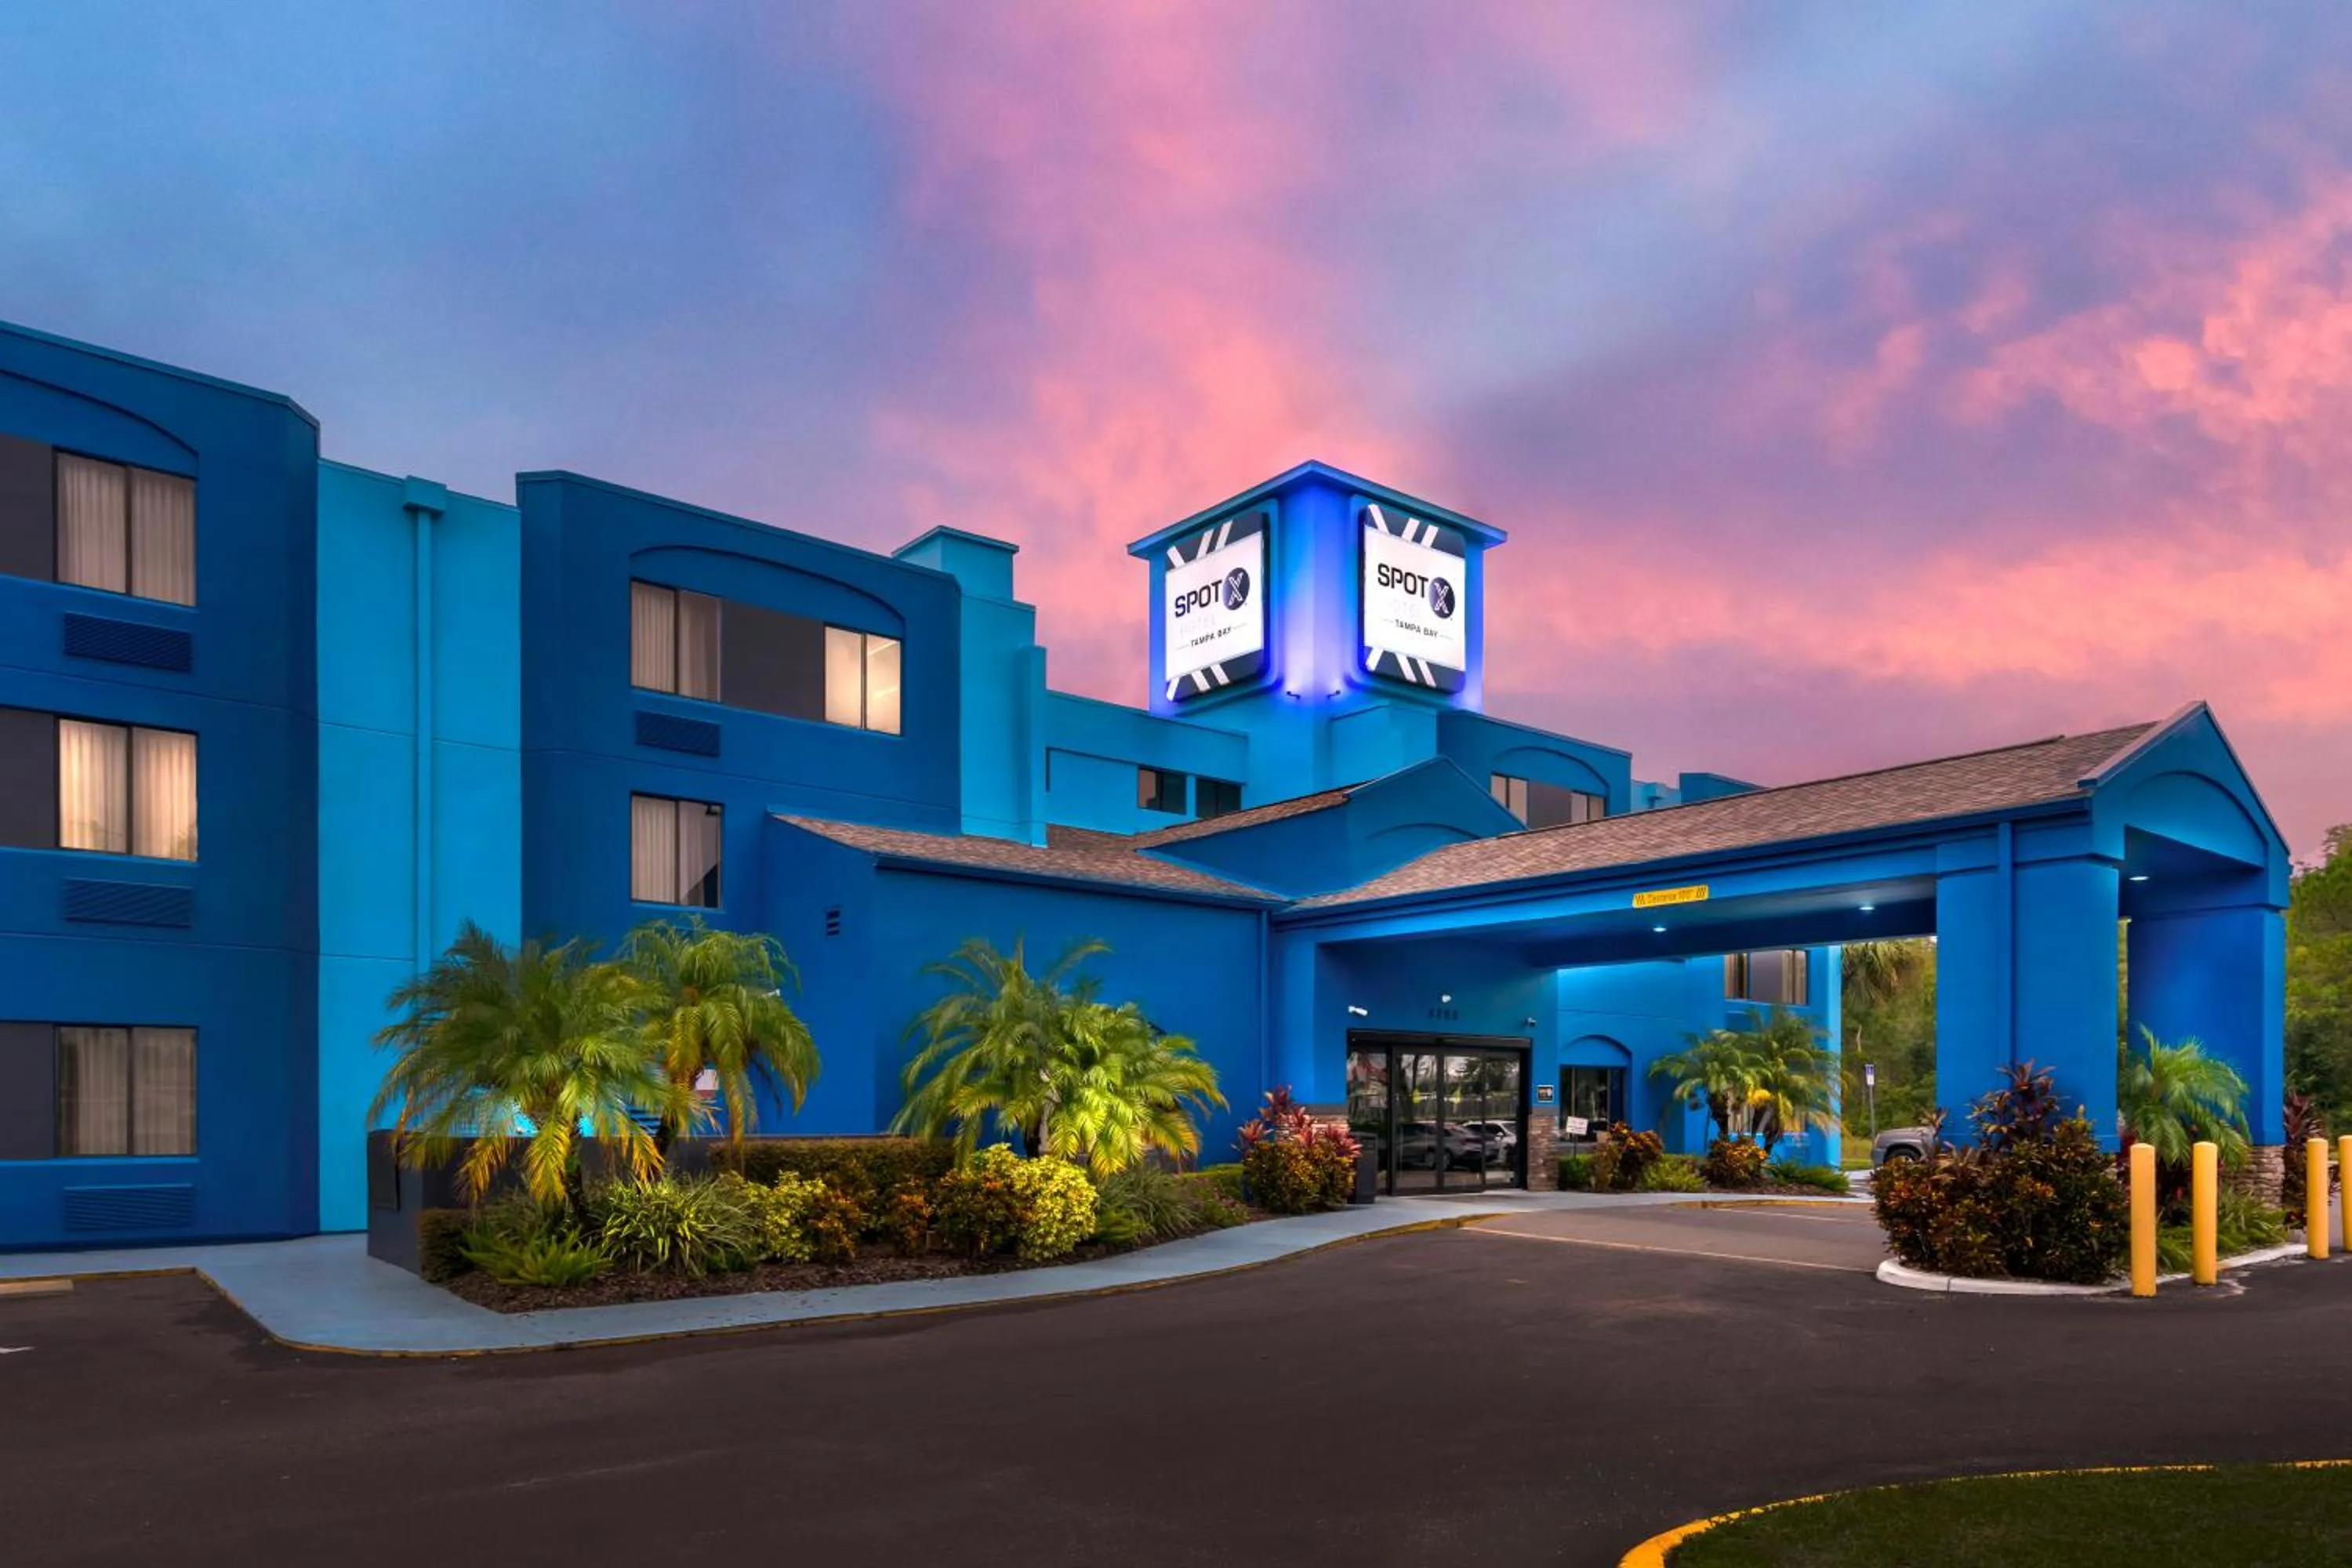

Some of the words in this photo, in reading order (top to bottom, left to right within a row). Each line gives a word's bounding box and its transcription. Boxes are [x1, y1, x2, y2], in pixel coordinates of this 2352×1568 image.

[1377, 563, 1428, 598] SPOT
[1174, 579, 1222, 618] SPOT
[1191, 633, 1214, 647] TAMPA
[1218, 626, 1232, 637] BAY
[1396, 619, 1421, 633] TAMPA
[1423, 627, 1438, 638] BAY
